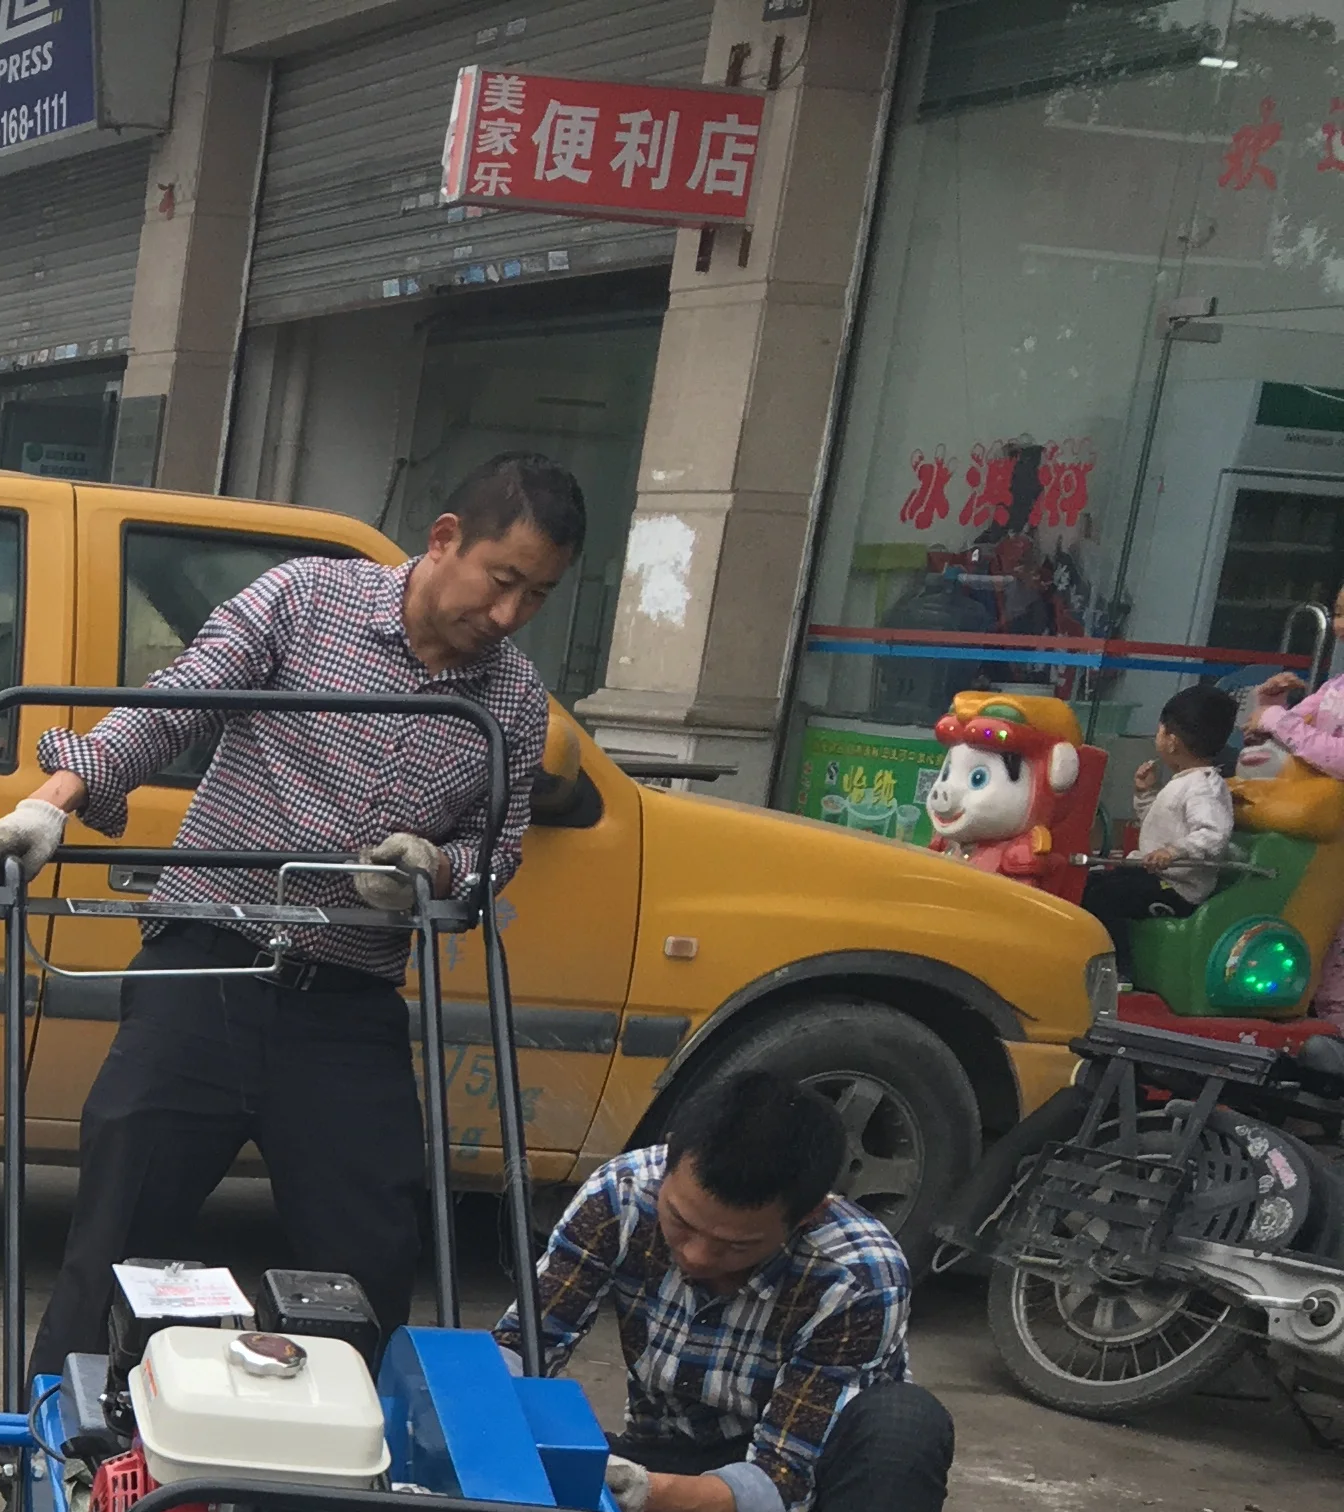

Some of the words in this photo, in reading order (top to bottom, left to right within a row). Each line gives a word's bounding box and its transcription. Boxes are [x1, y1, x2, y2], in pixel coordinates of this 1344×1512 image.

[470, 74, 526, 196] 美家乐
[532, 98, 759, 196] 便利店
